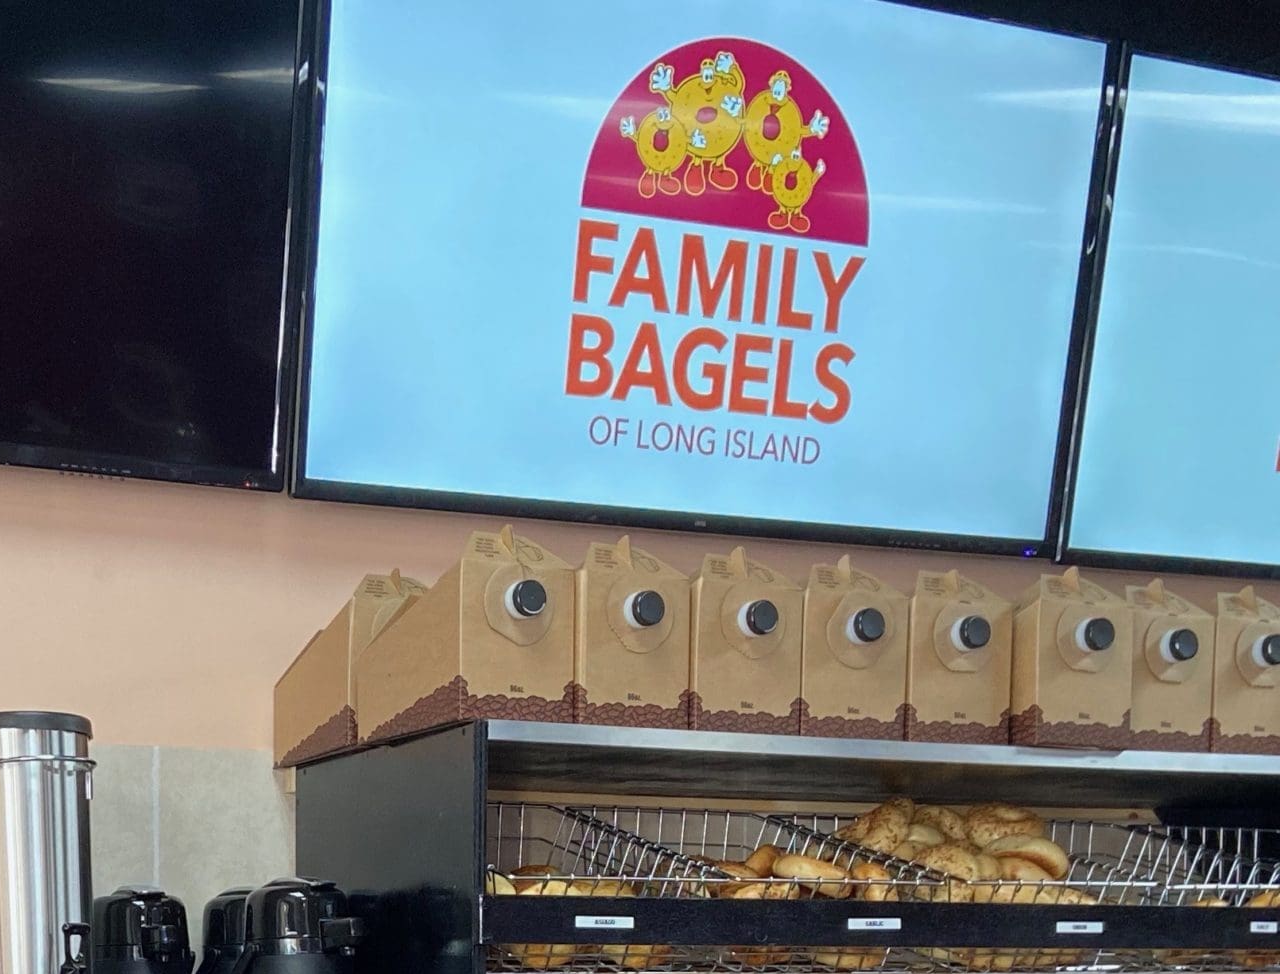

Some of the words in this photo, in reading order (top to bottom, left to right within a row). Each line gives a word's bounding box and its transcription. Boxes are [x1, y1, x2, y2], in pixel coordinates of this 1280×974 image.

[572, 218, 867, 334] FAMILY
[564, 313, 857, 425] BAGELS
[588, 415, 629, 447] OF
[636, 420, 716, 456] LONG
[724, 428, 821, 465] ISLAND
